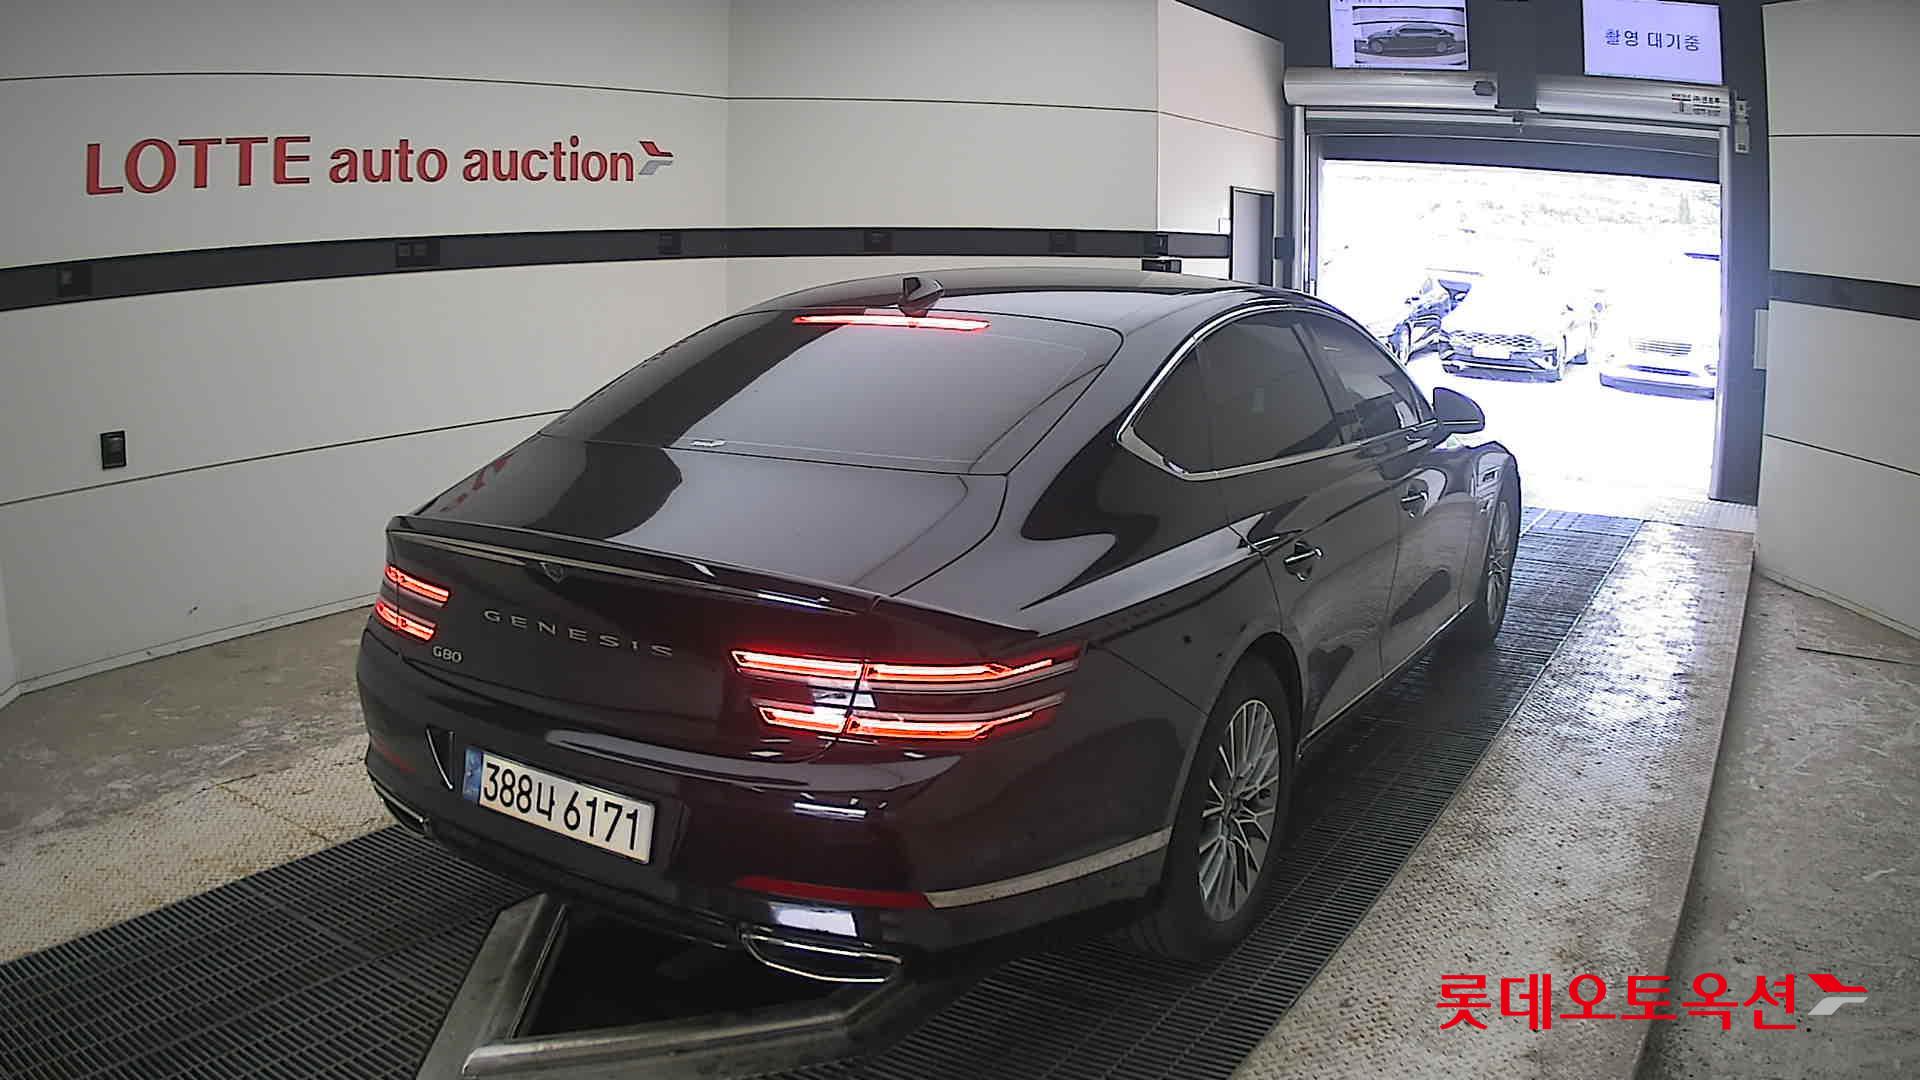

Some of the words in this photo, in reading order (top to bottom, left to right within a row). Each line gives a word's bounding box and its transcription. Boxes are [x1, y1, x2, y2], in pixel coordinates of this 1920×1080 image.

[1647, 31, 1701, 52] 대기중
[87, 136, 311, 195] LOTTE
[328, 138, 449, 183] auto
[462, 134, 635, 182] auction
[432, 646, 463, 664] G80
[483, 609, 674, 658] GENESIS
[482, 762, 557, 822] 388나
[563, 790, 641, 851] 6171
